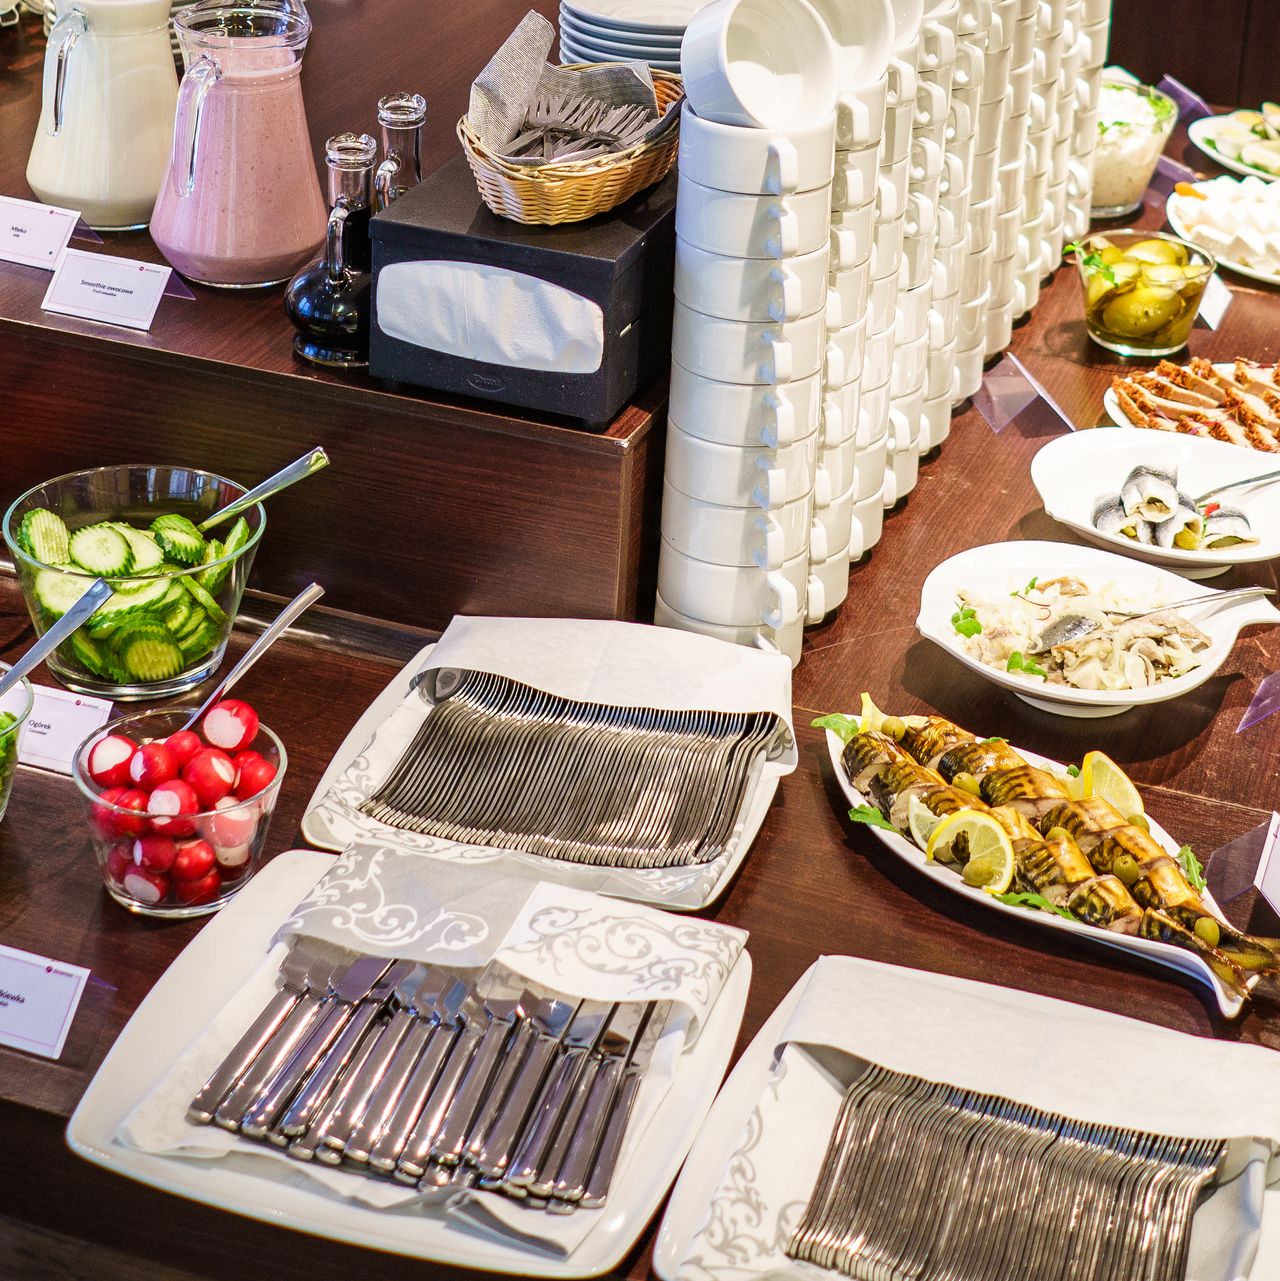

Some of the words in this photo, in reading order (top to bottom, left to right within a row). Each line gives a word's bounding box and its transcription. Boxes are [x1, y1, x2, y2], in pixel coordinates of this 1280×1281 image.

[80, 279, 107, 290] Smoothie
[107, 284, 134, 296] owocowe
[28, 719, 52, 731] Ogórek
